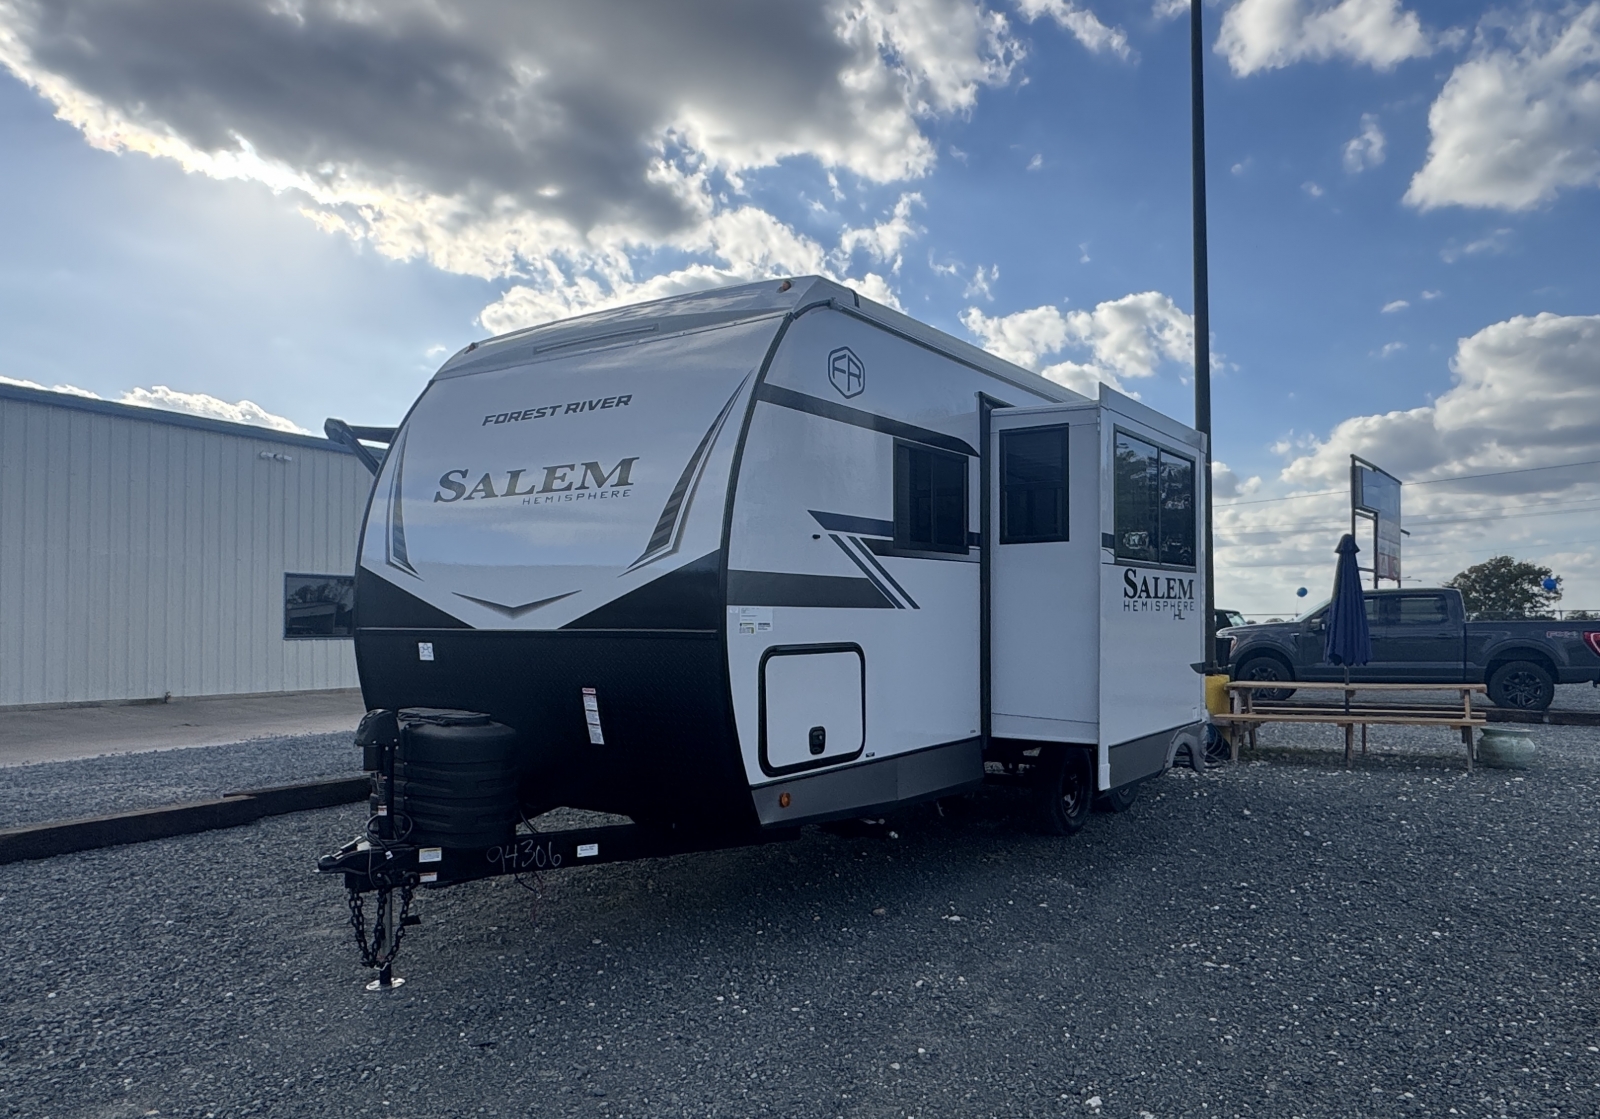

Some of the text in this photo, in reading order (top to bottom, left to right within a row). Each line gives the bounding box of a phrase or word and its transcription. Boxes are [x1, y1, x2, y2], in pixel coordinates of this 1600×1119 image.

[482, 394, 633, 426] FOREST RIVER
[434, 456, 640, 503] SALEM
[522, 489, 631, 505] HEMISPHERE
[1123, 568, 1194, 599] SALEM
[1123, 600, 1195, 612] HEMISPHERE
[486, 839, 562, 872] 94306
